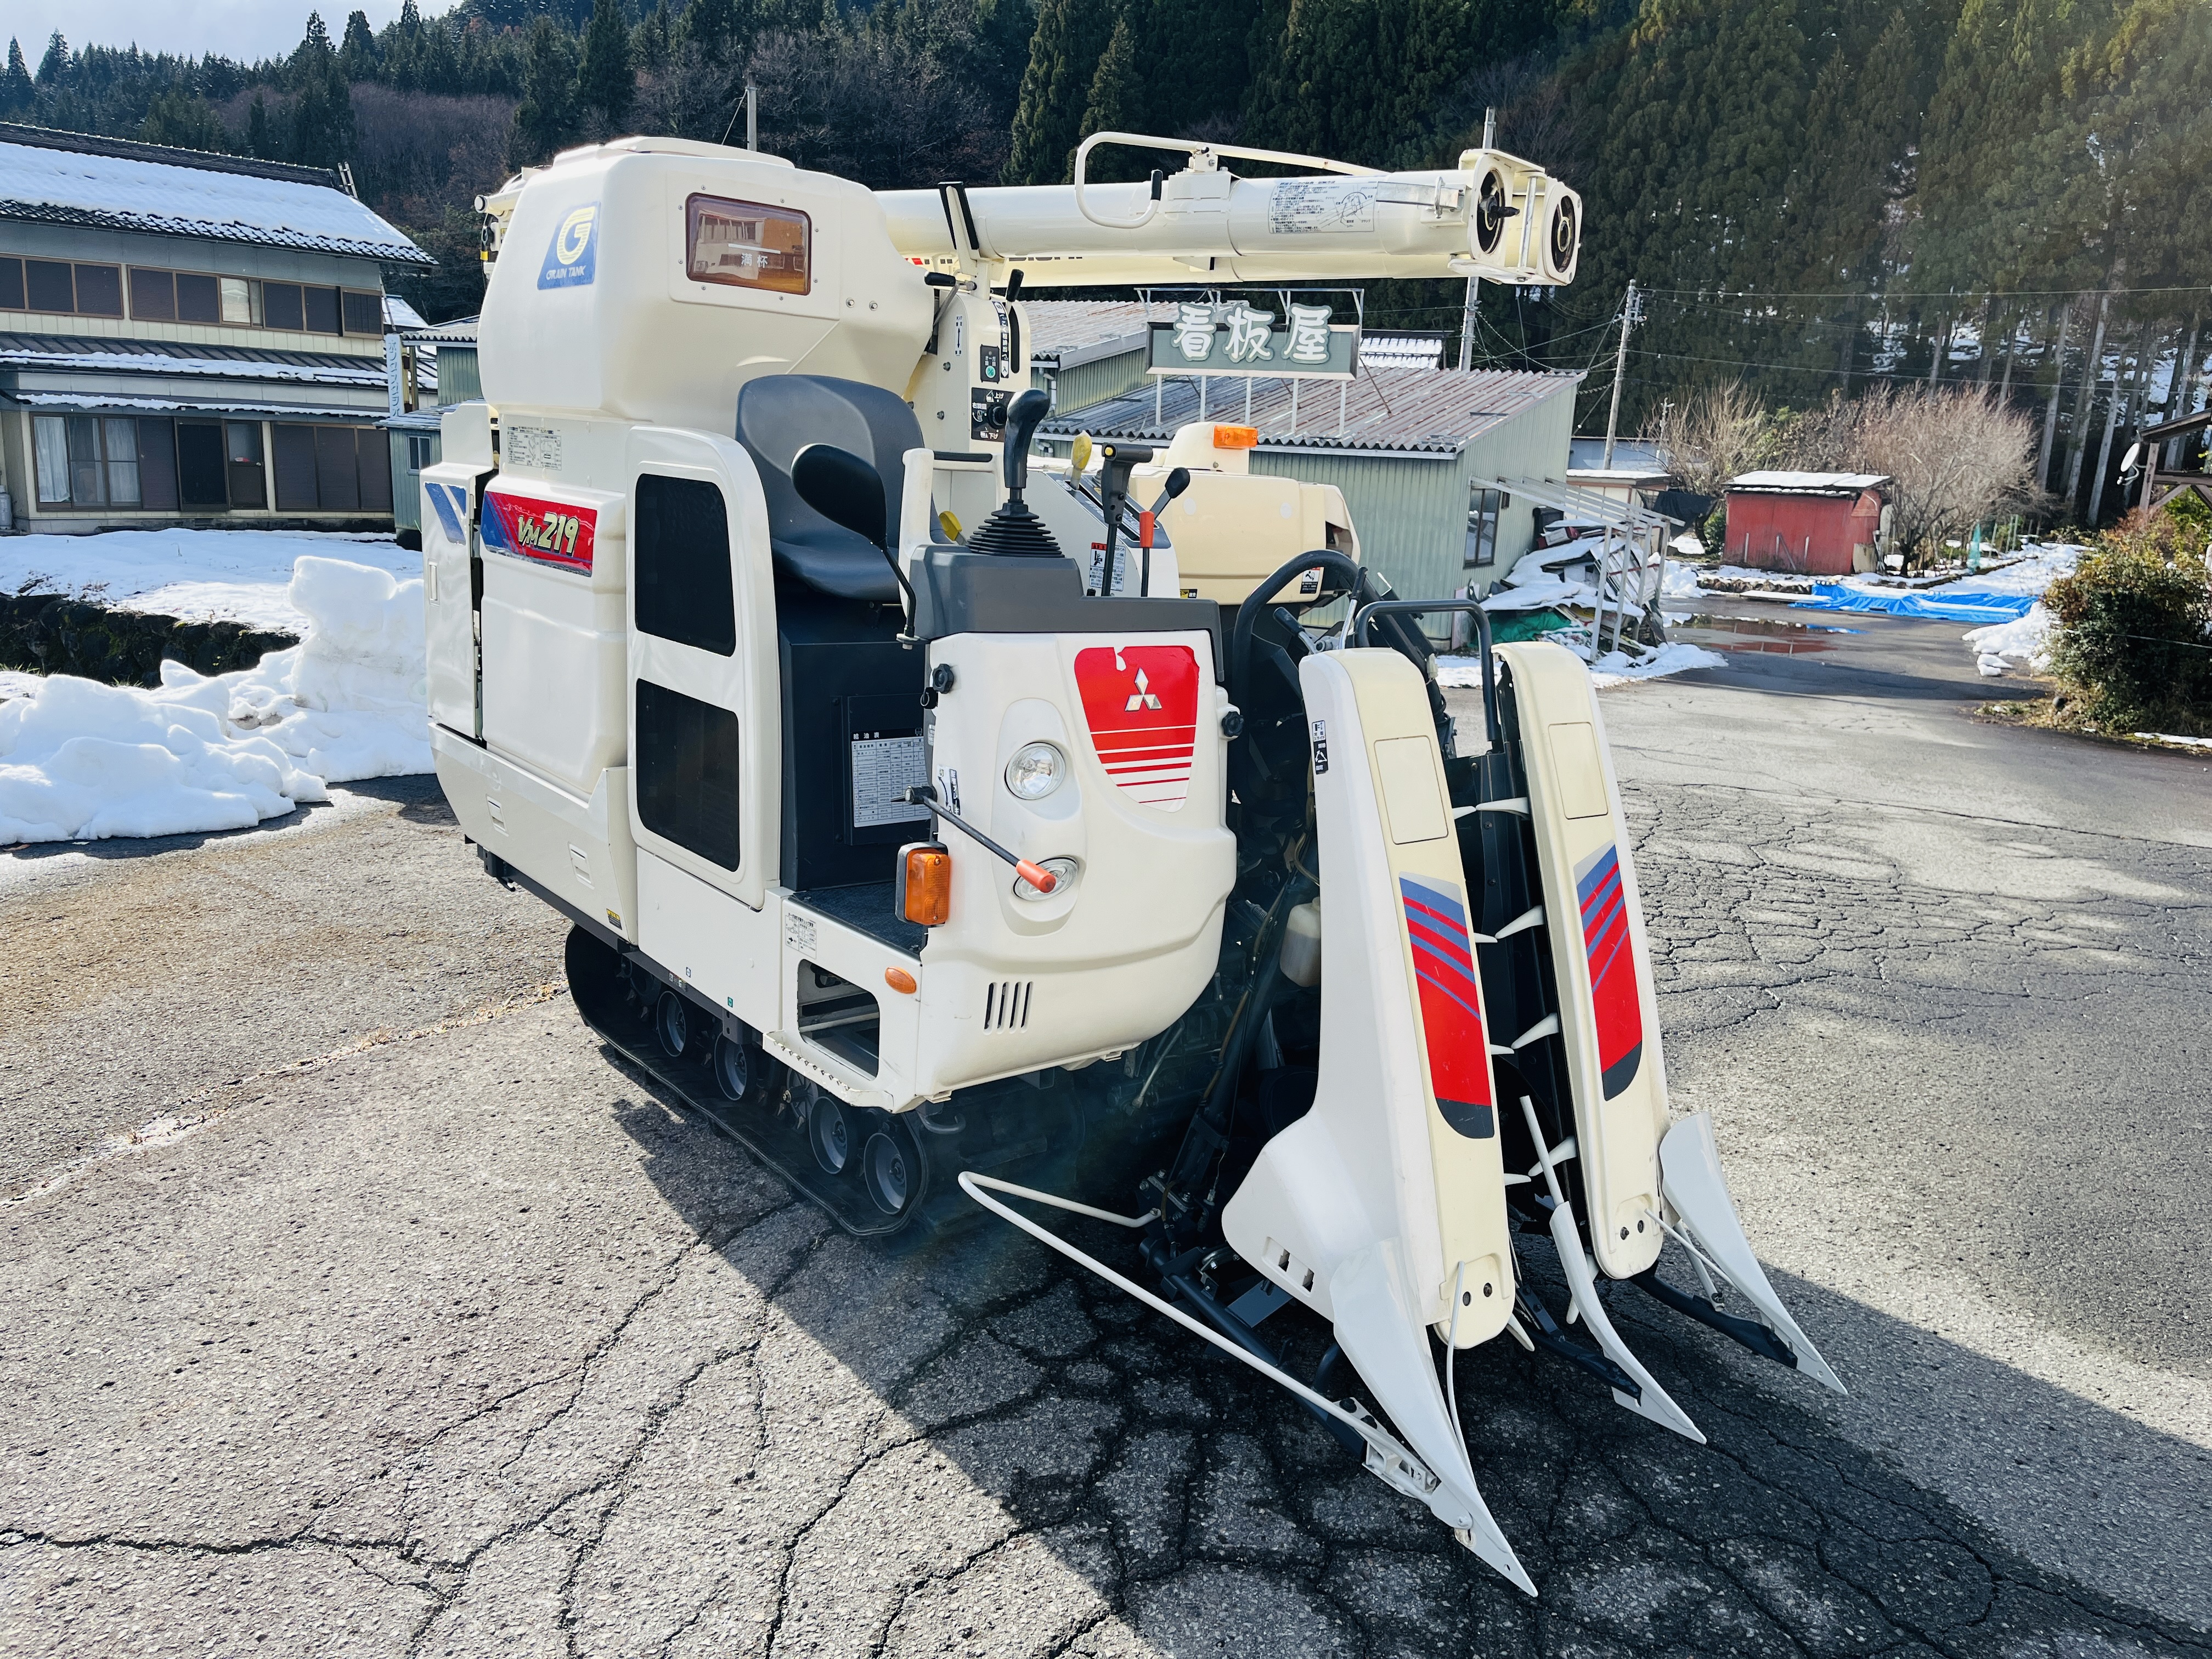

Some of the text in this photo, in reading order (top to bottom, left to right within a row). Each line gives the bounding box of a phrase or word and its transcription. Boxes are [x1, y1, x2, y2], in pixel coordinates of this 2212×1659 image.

[741, 252, 768, 269] 満杯
[546, 265, 587, 280] GRAIN TANK
[1172, 303, 1331, 363] 看板屋
